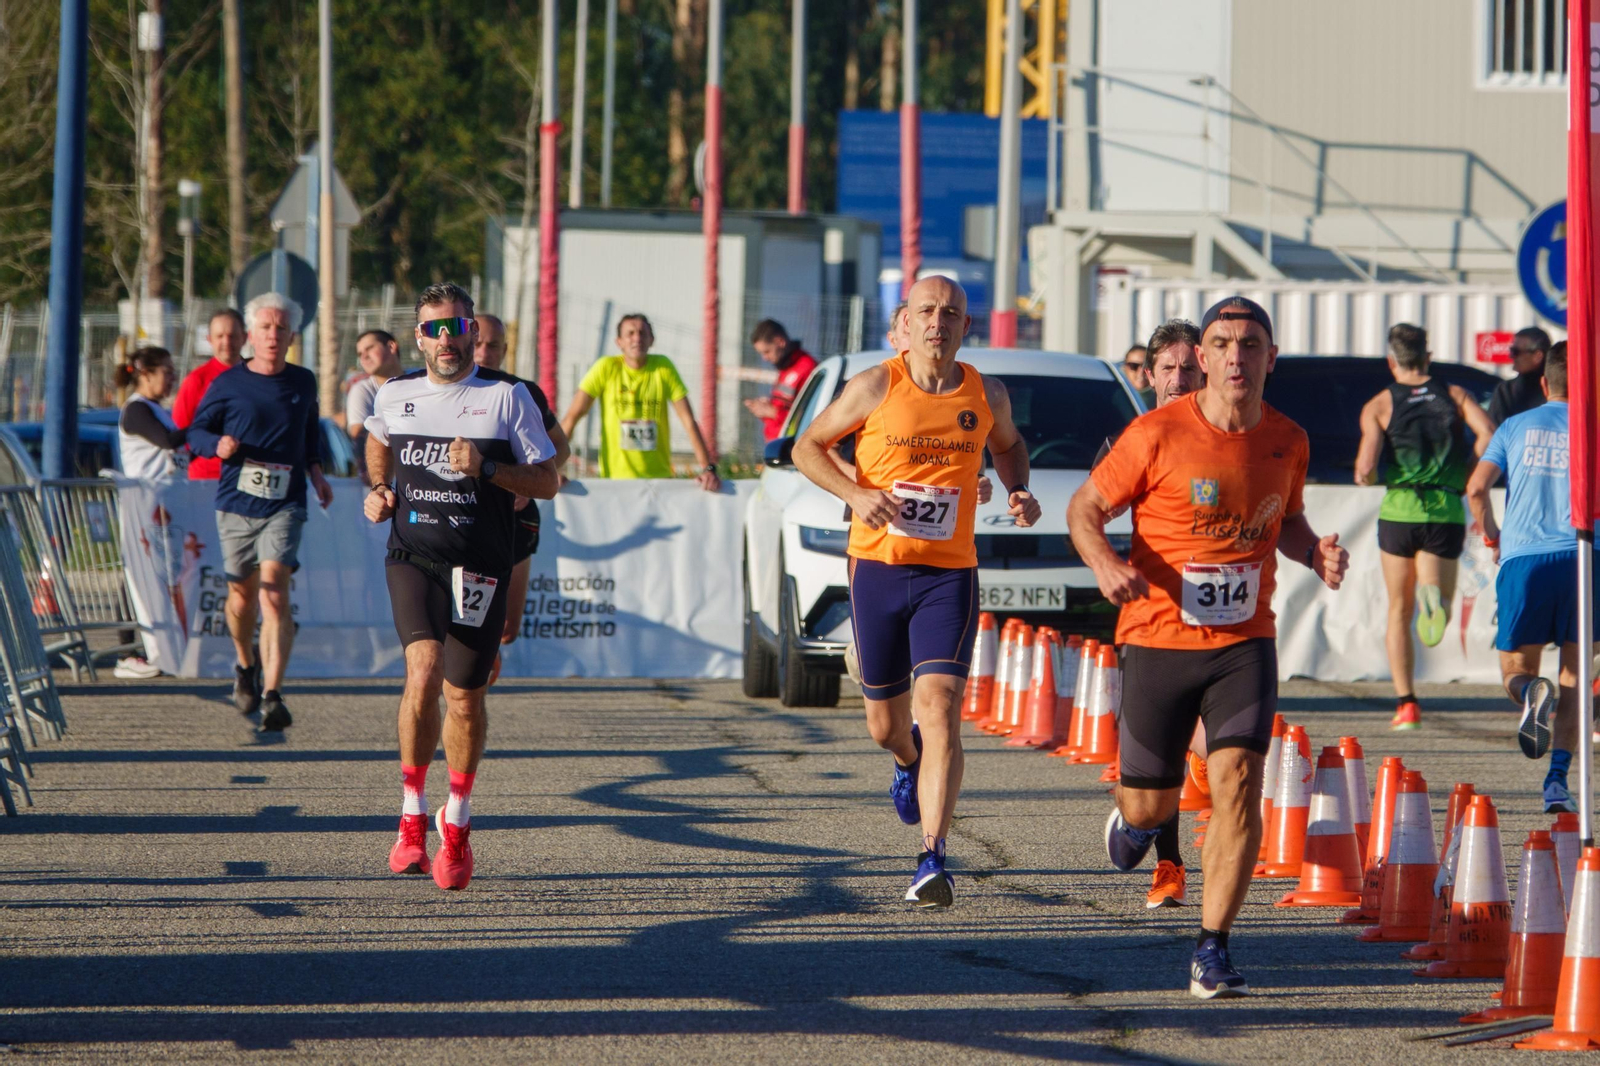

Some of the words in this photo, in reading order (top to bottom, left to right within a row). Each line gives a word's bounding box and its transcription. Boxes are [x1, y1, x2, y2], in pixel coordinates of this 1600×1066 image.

[400, 440, 451, 467] delik
[886, 434, 979, 454] SAMERTOLAMEU
[909, 451, 951, 468] MOAÑA
[1523, 446, 1569, 470] CELES
[251, 471, 281, 490] 311
[901, 498, 950, 525] 327
[1194, 510, 1242, 524] Running
[528, 572, 616, 593] deración
[463, 586, 484, 611] 22
[1022, 587, 1061, 607] NFN
[1197, 581, 1249, 607] 314
[524, 594, 594, 621] alega
[596, 601, 616, 615] de
[519, 617, 617, 639] tletismo
[1460, 905, 1512, 925] A.D.VIG
